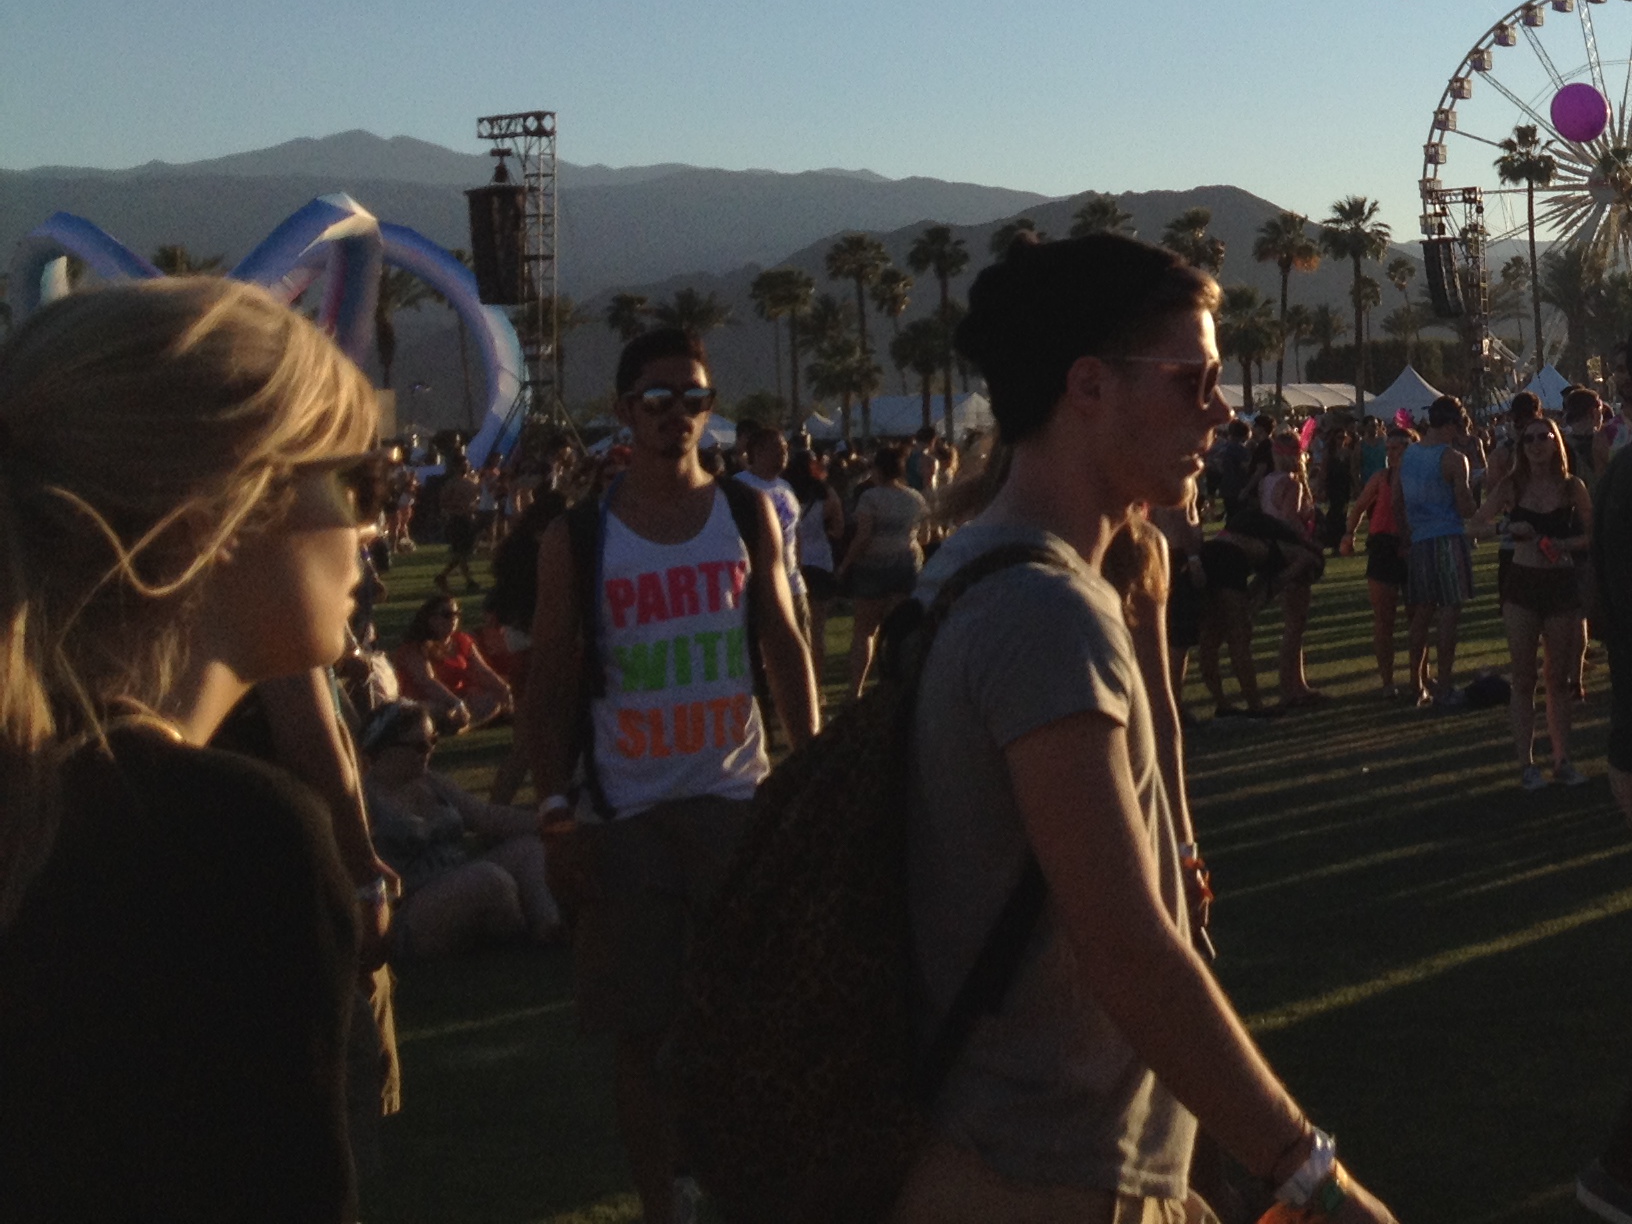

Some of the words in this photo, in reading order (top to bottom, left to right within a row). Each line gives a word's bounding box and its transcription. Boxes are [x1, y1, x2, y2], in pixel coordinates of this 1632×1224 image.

[605, 560, 746, 629] PARTY
[614, 628, 747, 693] WITH
[616, 693, 748, 761] SLUTS
